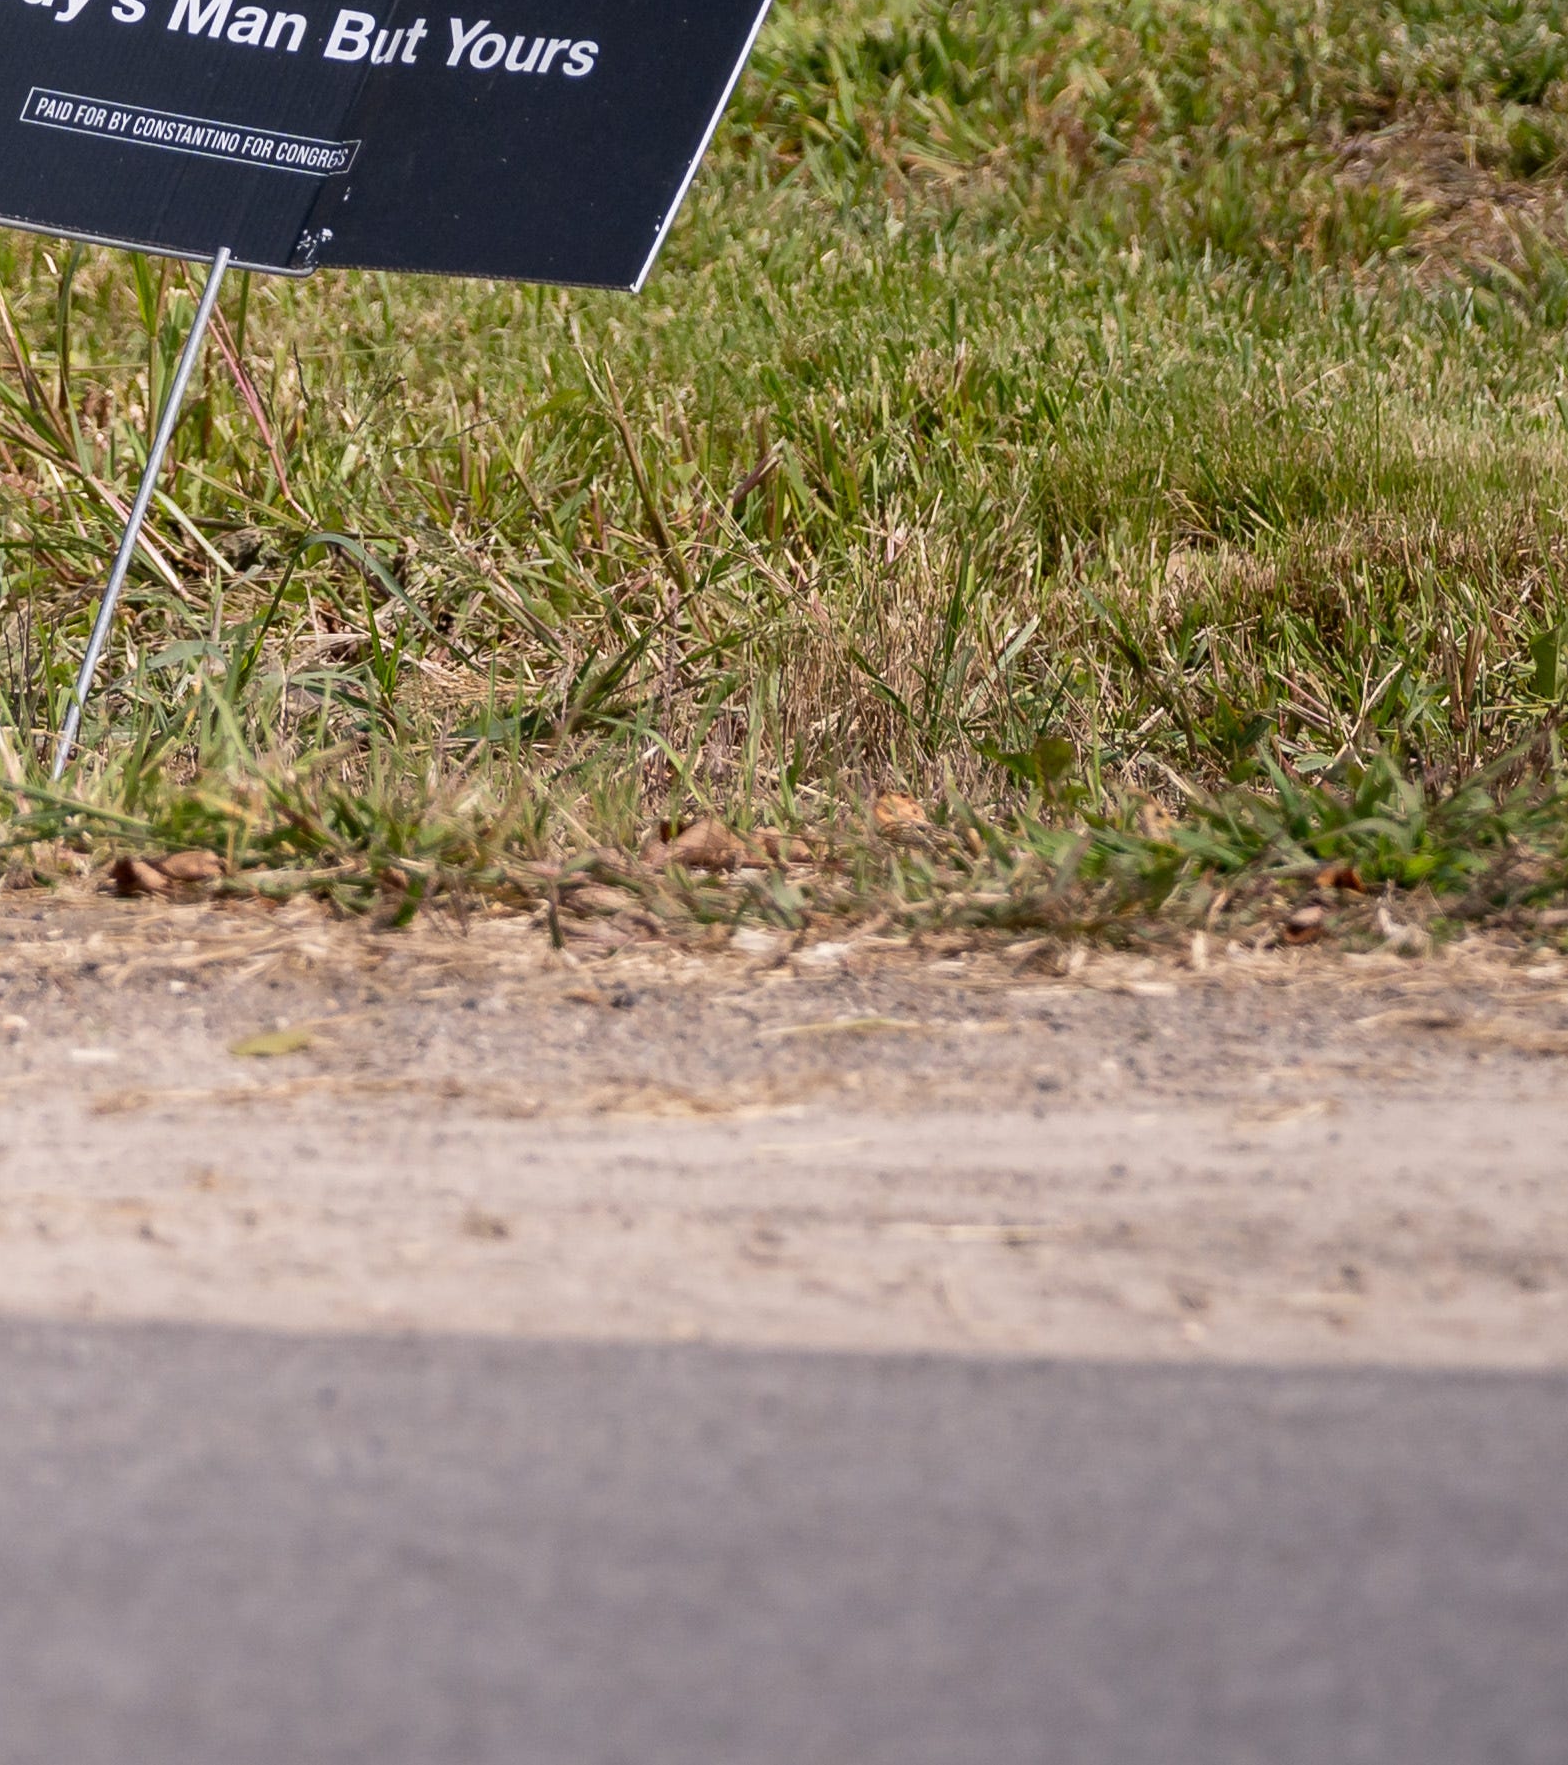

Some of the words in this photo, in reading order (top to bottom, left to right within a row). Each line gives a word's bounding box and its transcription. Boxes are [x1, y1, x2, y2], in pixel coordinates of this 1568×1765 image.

[323, 8, 429, 65] But
[445, 16, 600, 77] Yours
[34, 97, 74, 121] PAID
[73, 104, 106, 128] FOR
[108, 110, 135, 133] BY
[132, 116, 241, 152] CONSTANTINO
[241, 134, 274, 158] FOR
